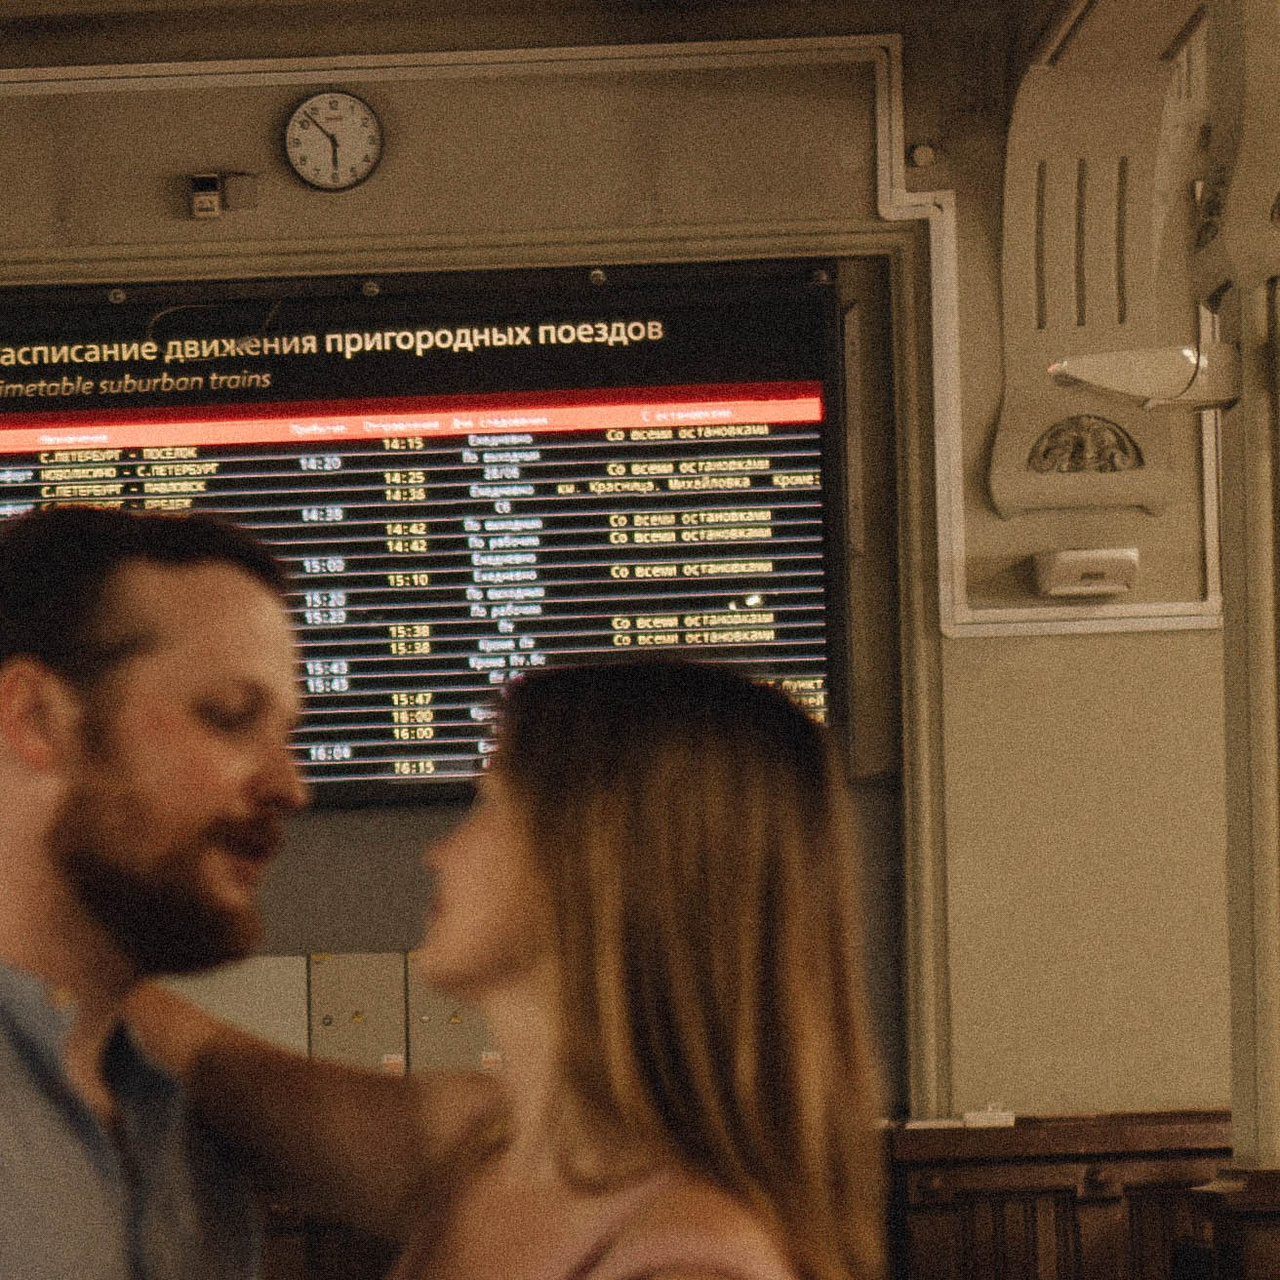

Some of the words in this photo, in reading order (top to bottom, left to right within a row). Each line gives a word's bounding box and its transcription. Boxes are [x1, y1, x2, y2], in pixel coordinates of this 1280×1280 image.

[164, 334, 317, 365] движения
[325, 324, 531, 359] пригородных
[538, 318, 665, 349] поездов
[99, 373, 204, 395] suburban
[210, 371, 272, 390] trains
[383, 438, 424, 450] 14:15
[299, 457, 342, 470] 14:20
[384, 472, 425, 484] 14:25
[386, 523, 427, 535] 14:42
[387, 540, 427, 552] 14:42
[388, 574, 429, 586] 15:10
[389, 625, 430, 638] 15:38
[391, 642, 430, 655] 15:38
[392, 693, 432, 706] 15:47
[393, 727, 434, 740] 16:00
[394, 761, 434, 774] 16:15
